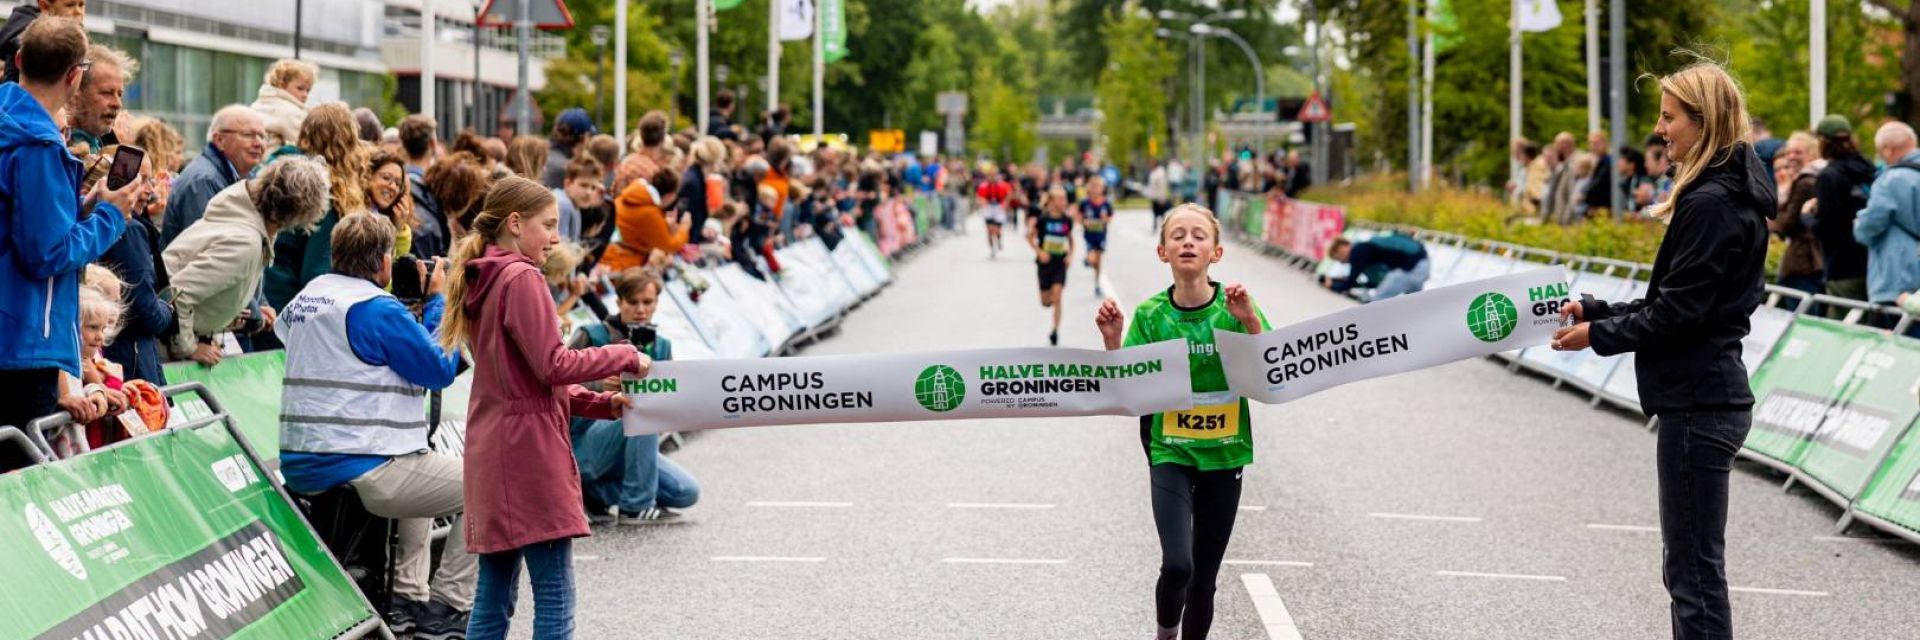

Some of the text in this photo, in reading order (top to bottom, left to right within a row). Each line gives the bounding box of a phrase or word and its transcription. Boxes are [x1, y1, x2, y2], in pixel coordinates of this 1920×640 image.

[1263, 323, 1358, 364] CAMPUS
[979, 359, 1162, 379] HALVE MARATHON
[1266, 333, 1409, 384] GRONINGEN
[721, 371, 824, 393] CAMPUS
[981, 379, 1101, 396] GRONINGEN
[722, 391, 873, 413] GRONINGEN
[1177, 413, 1226, 430] K251
